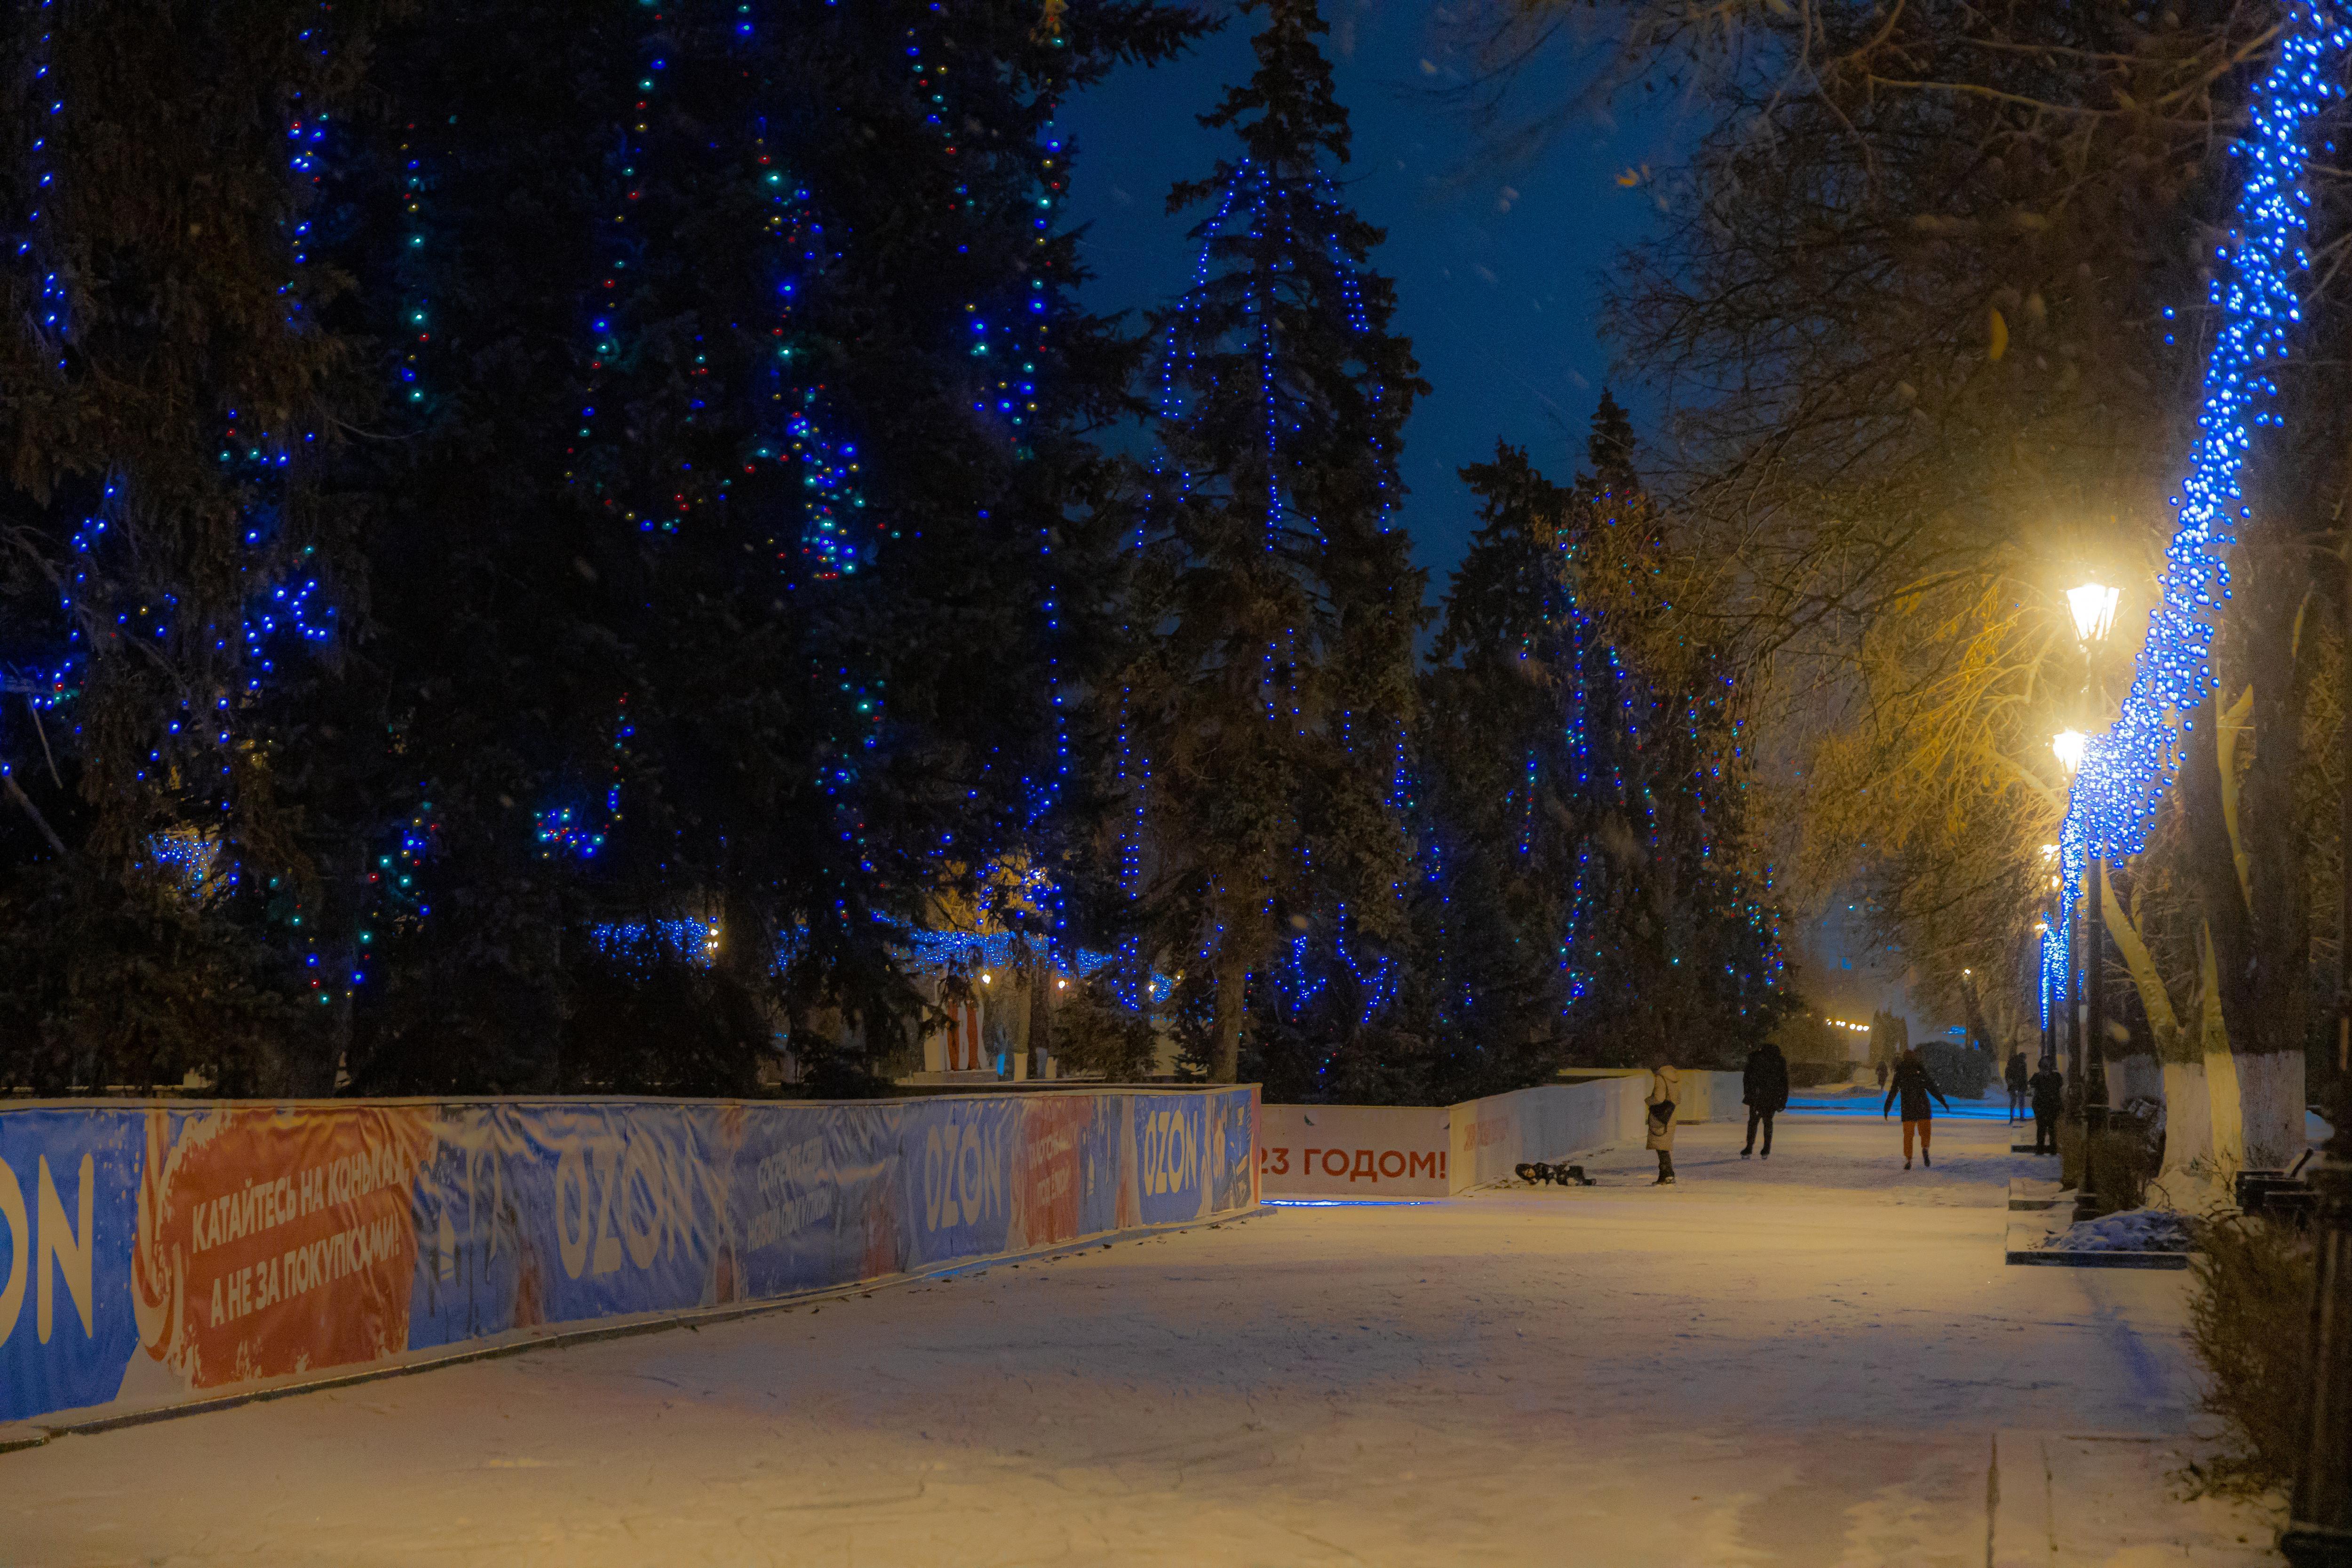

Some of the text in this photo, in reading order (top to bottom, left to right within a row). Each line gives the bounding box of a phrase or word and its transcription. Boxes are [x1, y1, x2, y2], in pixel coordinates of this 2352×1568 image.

[924, 1123, 1002, 1232] OZON
[1144, 1109, 1198, 1196] OZON
[1304, 1149, 1446, 1182] ГОДОМ!
[193, 1178, 296, 1253] КАТАЙТЕСЬ
[301, 1166, 324, 1216] НА
[556, 1134, 693, 1279] OZON
[211, 1212, 401, 1328] А НЕ ЗА ПОКУПКАМИ!
